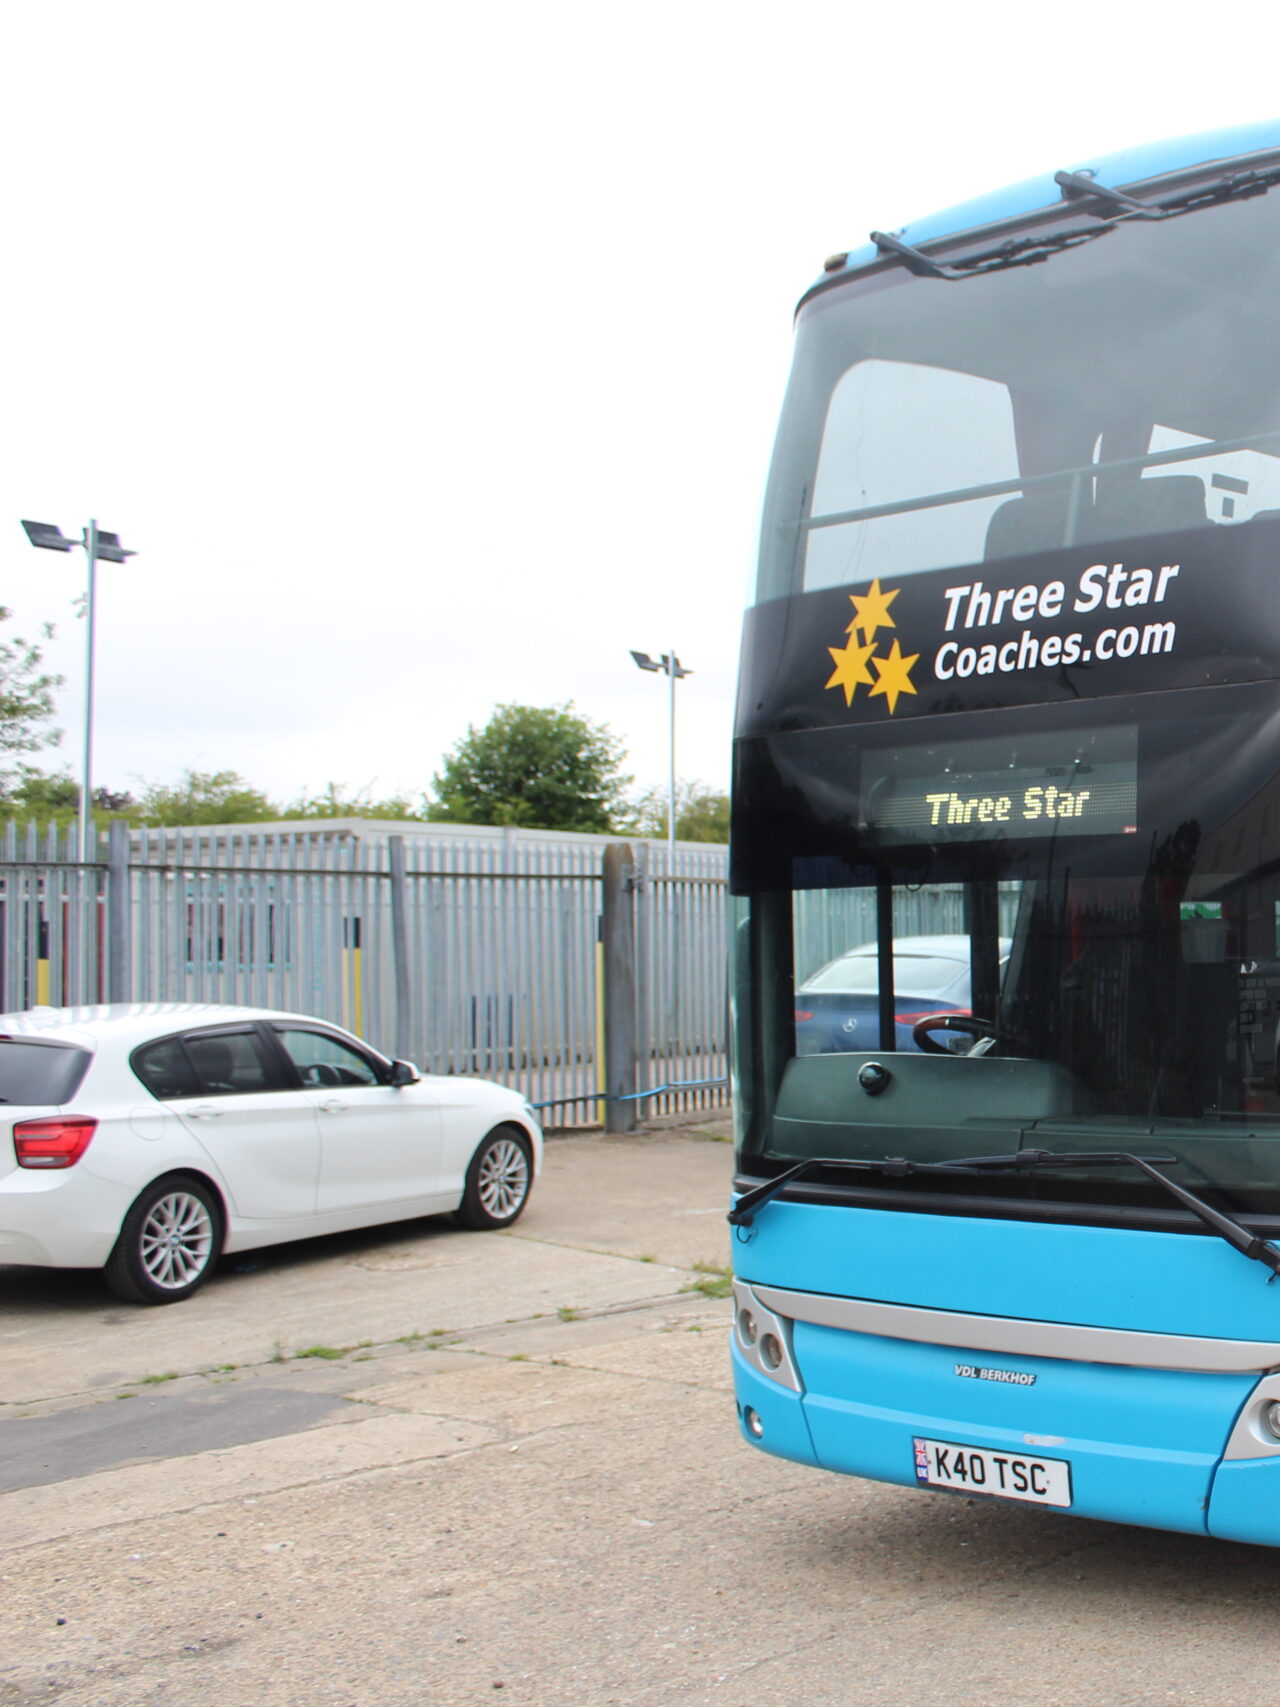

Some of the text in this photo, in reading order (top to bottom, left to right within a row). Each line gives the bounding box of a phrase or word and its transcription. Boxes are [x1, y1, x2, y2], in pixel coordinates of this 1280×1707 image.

[944, 563, 1180, 631] Three Star
[934, 622, 1176, 681] Coaches.com
[926, 785, 1090, 826] Three Star
[953, 1364, 1037, 1386] VDL BERKHOF
[935, 1447, 1048, 1496] K40 TSC
